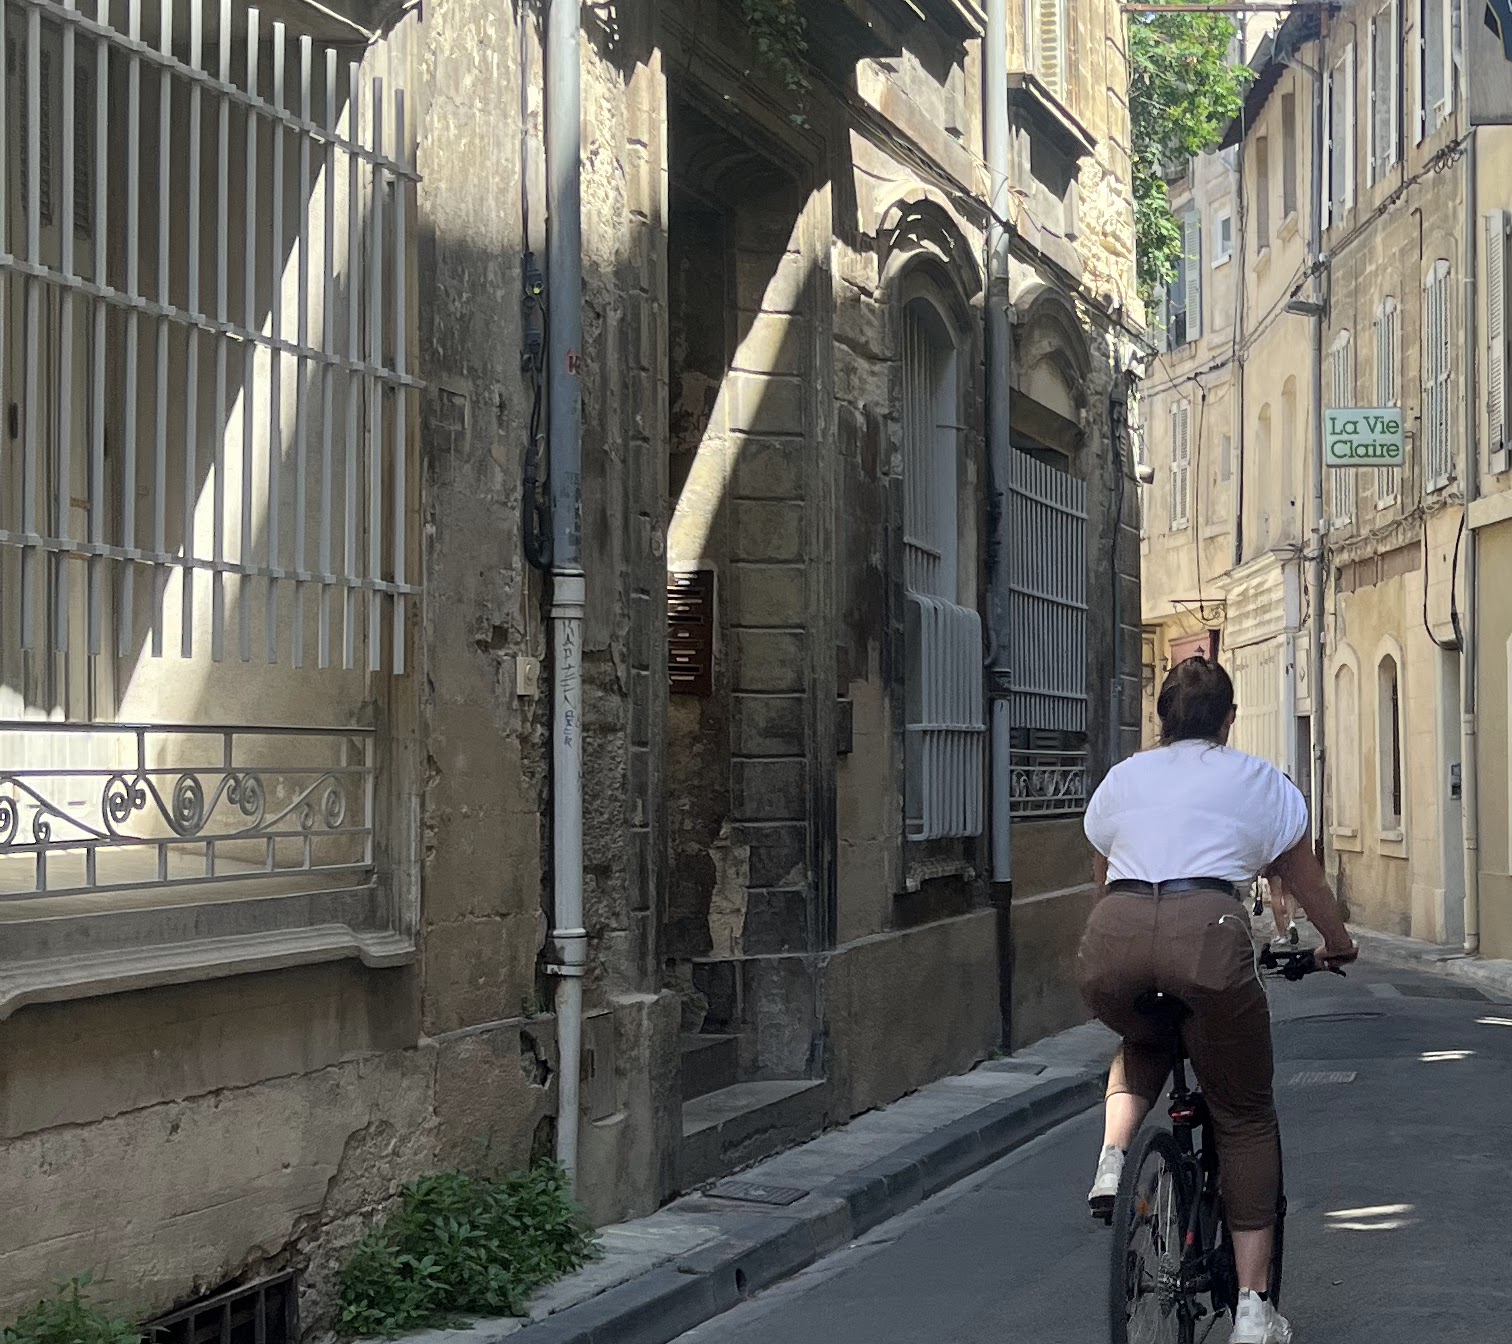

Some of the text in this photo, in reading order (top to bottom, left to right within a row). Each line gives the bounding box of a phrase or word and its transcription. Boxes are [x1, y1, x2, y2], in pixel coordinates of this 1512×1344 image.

[1329, 416, 1400, 435] La Vie
[1331, 439, 1400, 458] Claire
